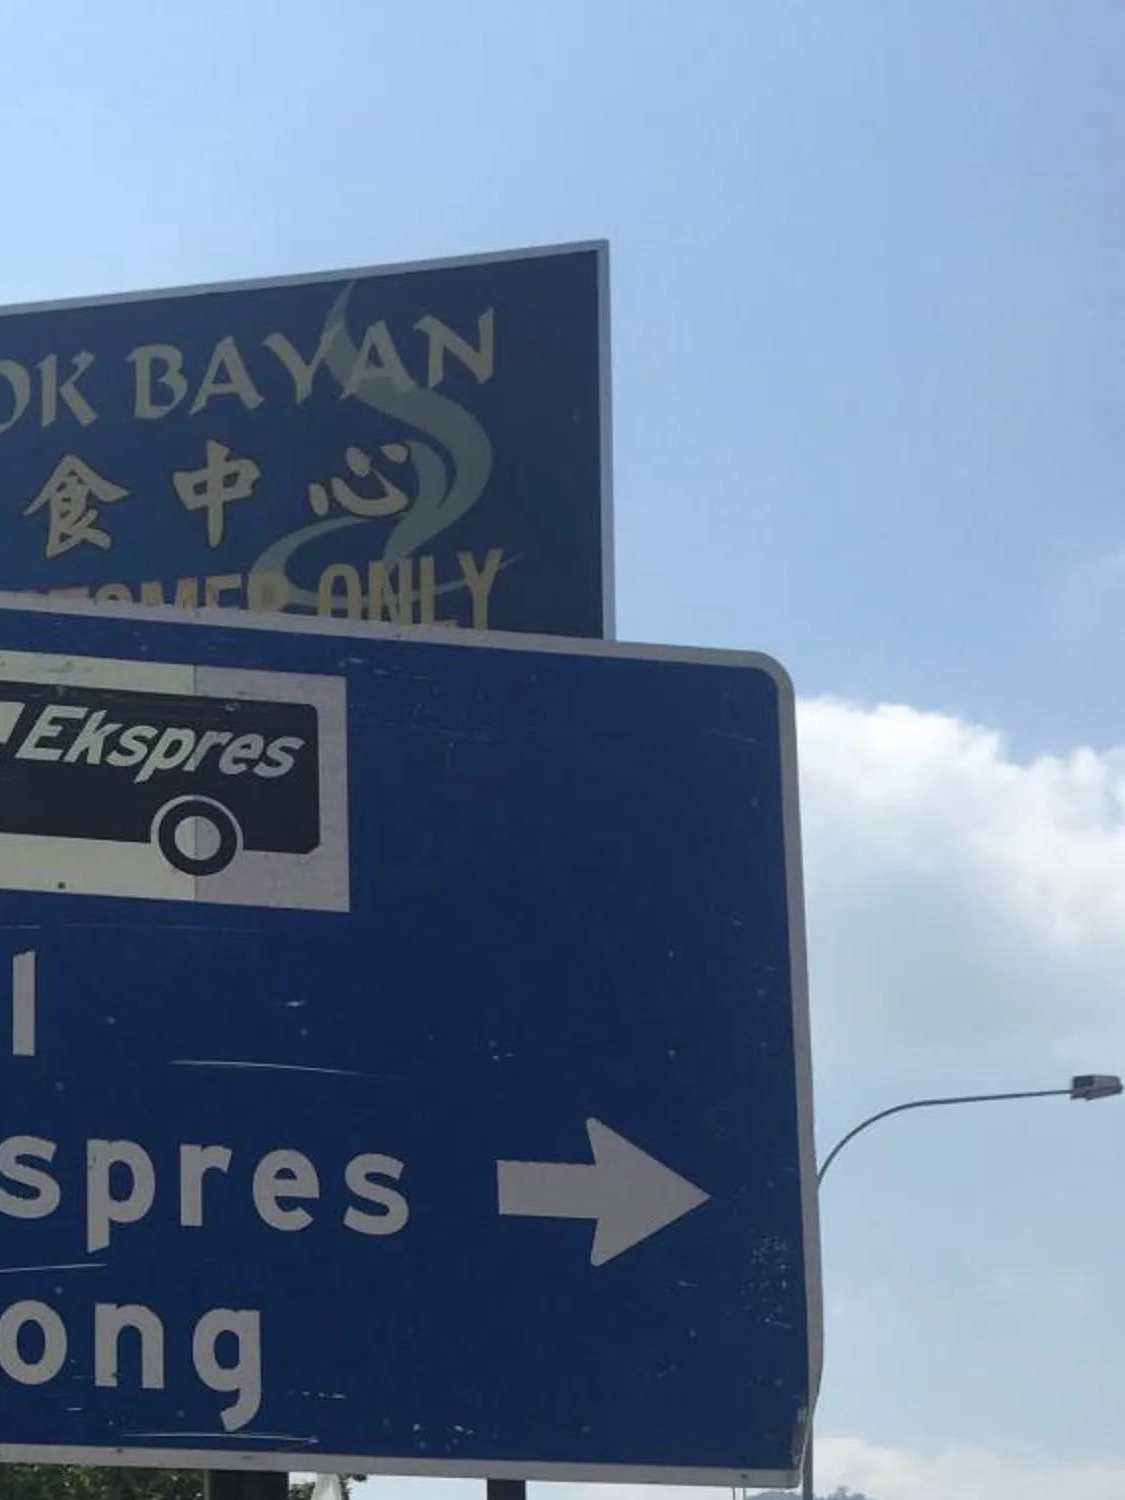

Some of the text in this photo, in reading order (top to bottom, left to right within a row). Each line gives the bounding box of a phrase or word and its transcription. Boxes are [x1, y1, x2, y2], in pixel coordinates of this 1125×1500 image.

[125, 306, 495, 421] BAYAN
[317, 549, 502, 628] ONLY
[14, 704, 305, 783] Ekspres
